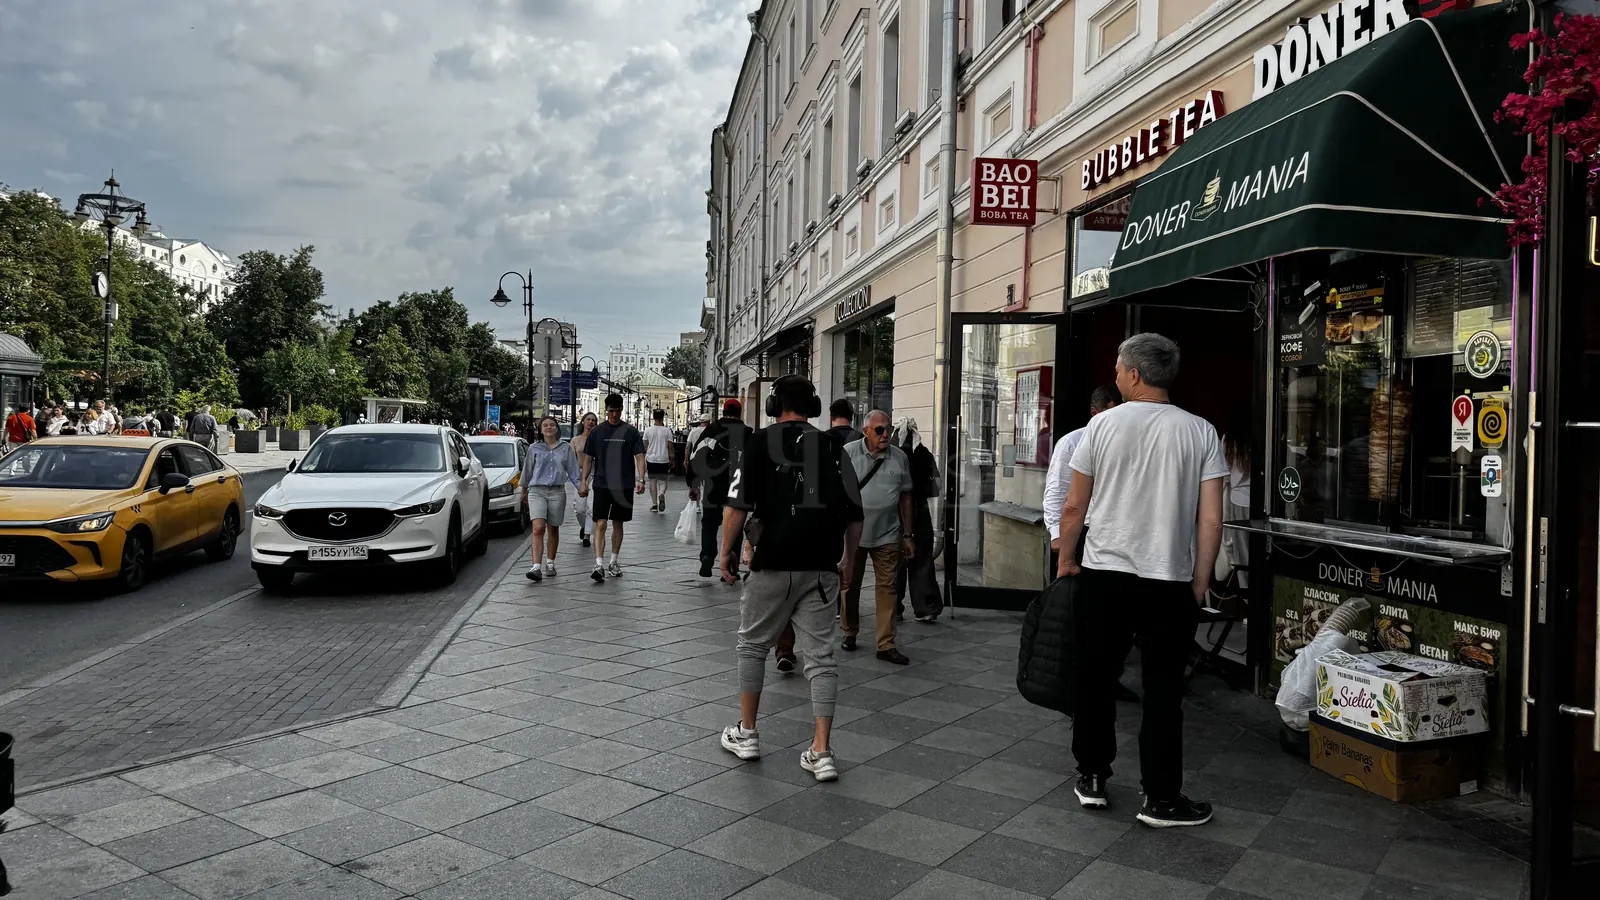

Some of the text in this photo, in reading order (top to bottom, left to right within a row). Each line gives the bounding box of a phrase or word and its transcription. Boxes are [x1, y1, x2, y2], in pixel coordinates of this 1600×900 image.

[1081, 90, 1217, 191] BUBBLE TEA
[981, 163, 1031, 184] BAO
[980, 184, 1031, 209] BEI
[1121, 151, 1310, 251] DONER MANIA
[980, 210, 1029, 220] BOBA TEA
[1280, 341, 1303, 354] КОФЕ
[1285, 352, 1303, 361] СОБОЙ
[1280, 473, 1299, 489] حلال
[1318, 563, 1438, 604] DONER MANIA
[1303, 586, 1340, 605] КЛАССИК
[1285, 608, 1299, 621] SEA
[1379, 603, 1409, 620] ЭЛИТА
[1346, 628, 1368, 642] HESE
[1453, 620, 1501, 641] МАКС БИФ
[1419, 643, 1449, 661] ВЕГАН
[1322, 735, 1374, 767] Palm Bananas
